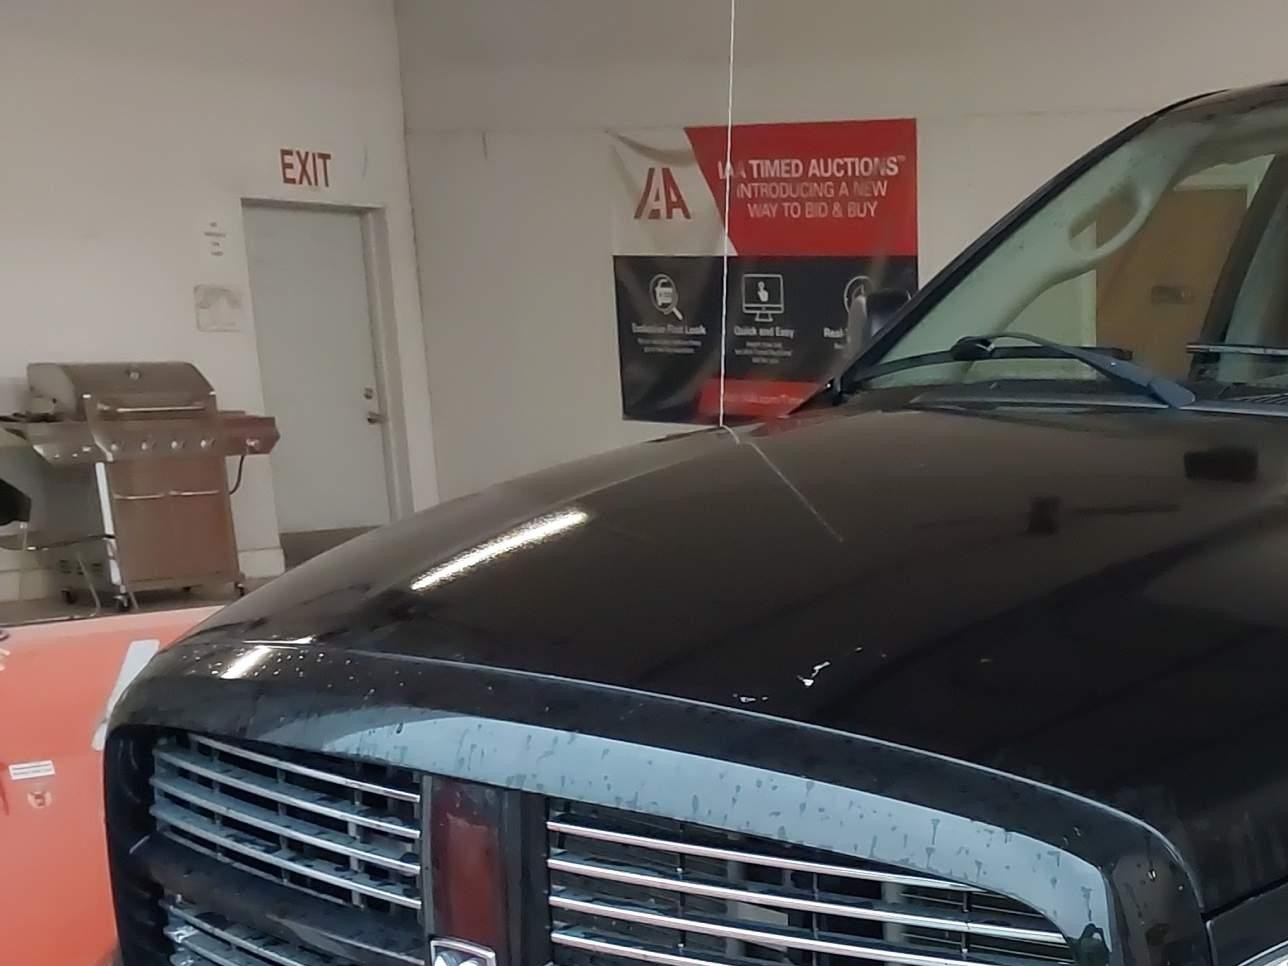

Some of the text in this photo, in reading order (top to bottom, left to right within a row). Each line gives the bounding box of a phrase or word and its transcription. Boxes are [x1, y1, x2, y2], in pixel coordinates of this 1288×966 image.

[280, 149, 331, 187] EXIT
[748, 158, 803, 179] TIMED
[736, 179, 888, 199] INTRODUCING A NEW
[747, 200, 878, 218] WAY TO BID & BUY
